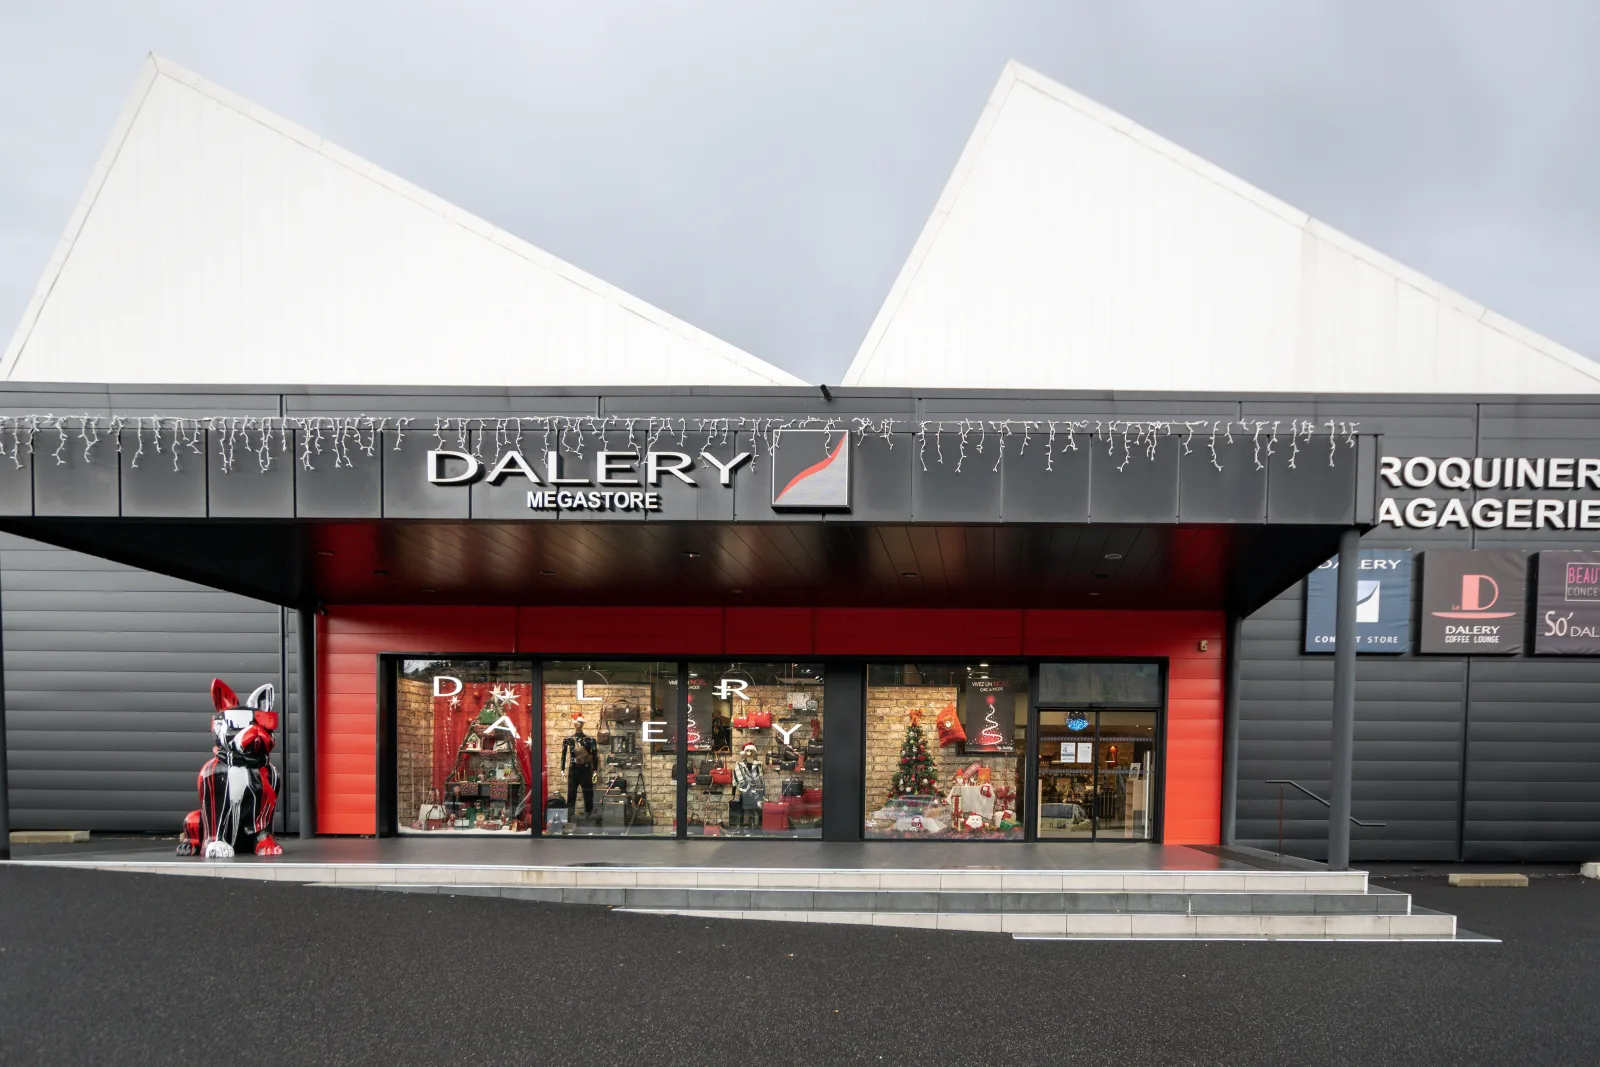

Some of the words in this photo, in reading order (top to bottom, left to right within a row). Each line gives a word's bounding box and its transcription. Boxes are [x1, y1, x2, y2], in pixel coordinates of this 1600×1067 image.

[427, 450, 751, 485] DALERY
[527, 491, 659, 509] MEGASTORE
[1568, 567, 1600, 584] BEAU
[1445, 625, 1501, 635] DALERY
[1314, 635, 1362, 643] CONT
[1367, 635, 1399, 644] STORE
[1445, 635, 1471, 644] COFFEE
[1473, 635, 1500, 644] LOUNGE
